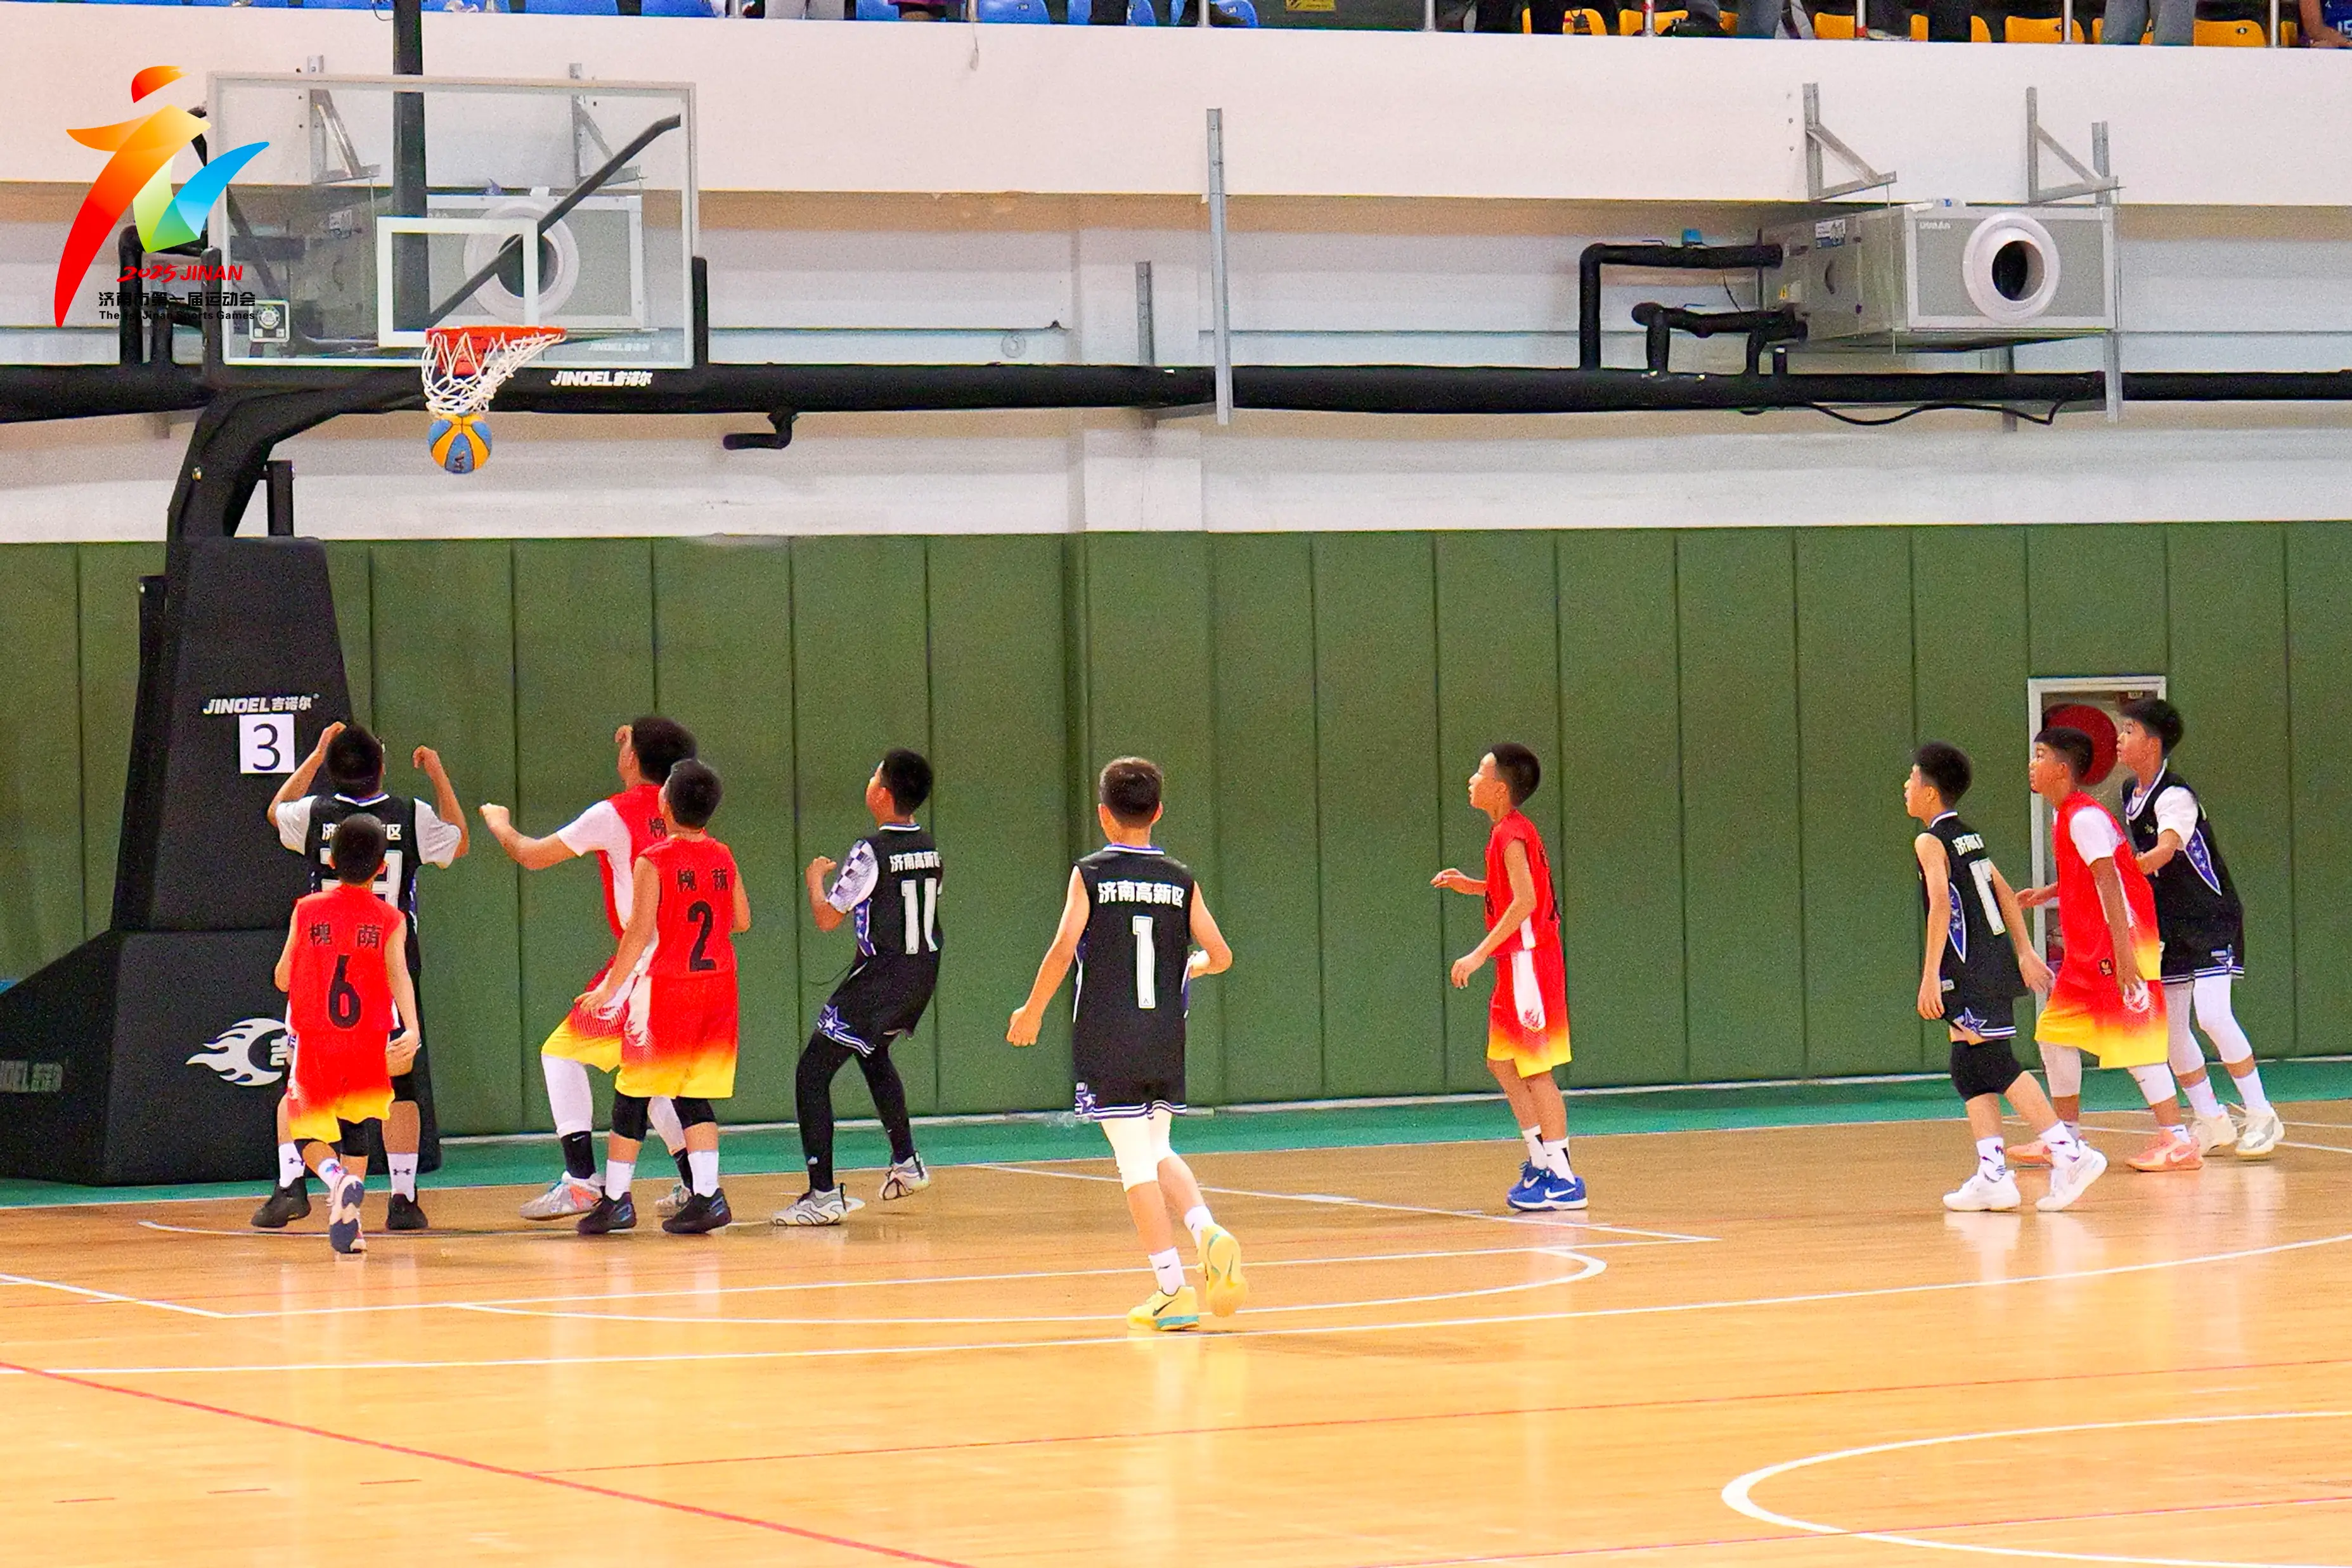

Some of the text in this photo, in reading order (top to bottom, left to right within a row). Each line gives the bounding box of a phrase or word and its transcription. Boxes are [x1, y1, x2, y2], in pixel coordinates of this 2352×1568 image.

[550, 371, 613, 387] JINOEL
[203, 697, 269, 715] JINOEL
[253, 723, 281, 771] 3
[1097, 880, 1185, 909] 济南高新区
[688, 900, 717, 973] 2
[1132, 915, 1156, 1009] 1
[328, 954, 361, 1029] 6
